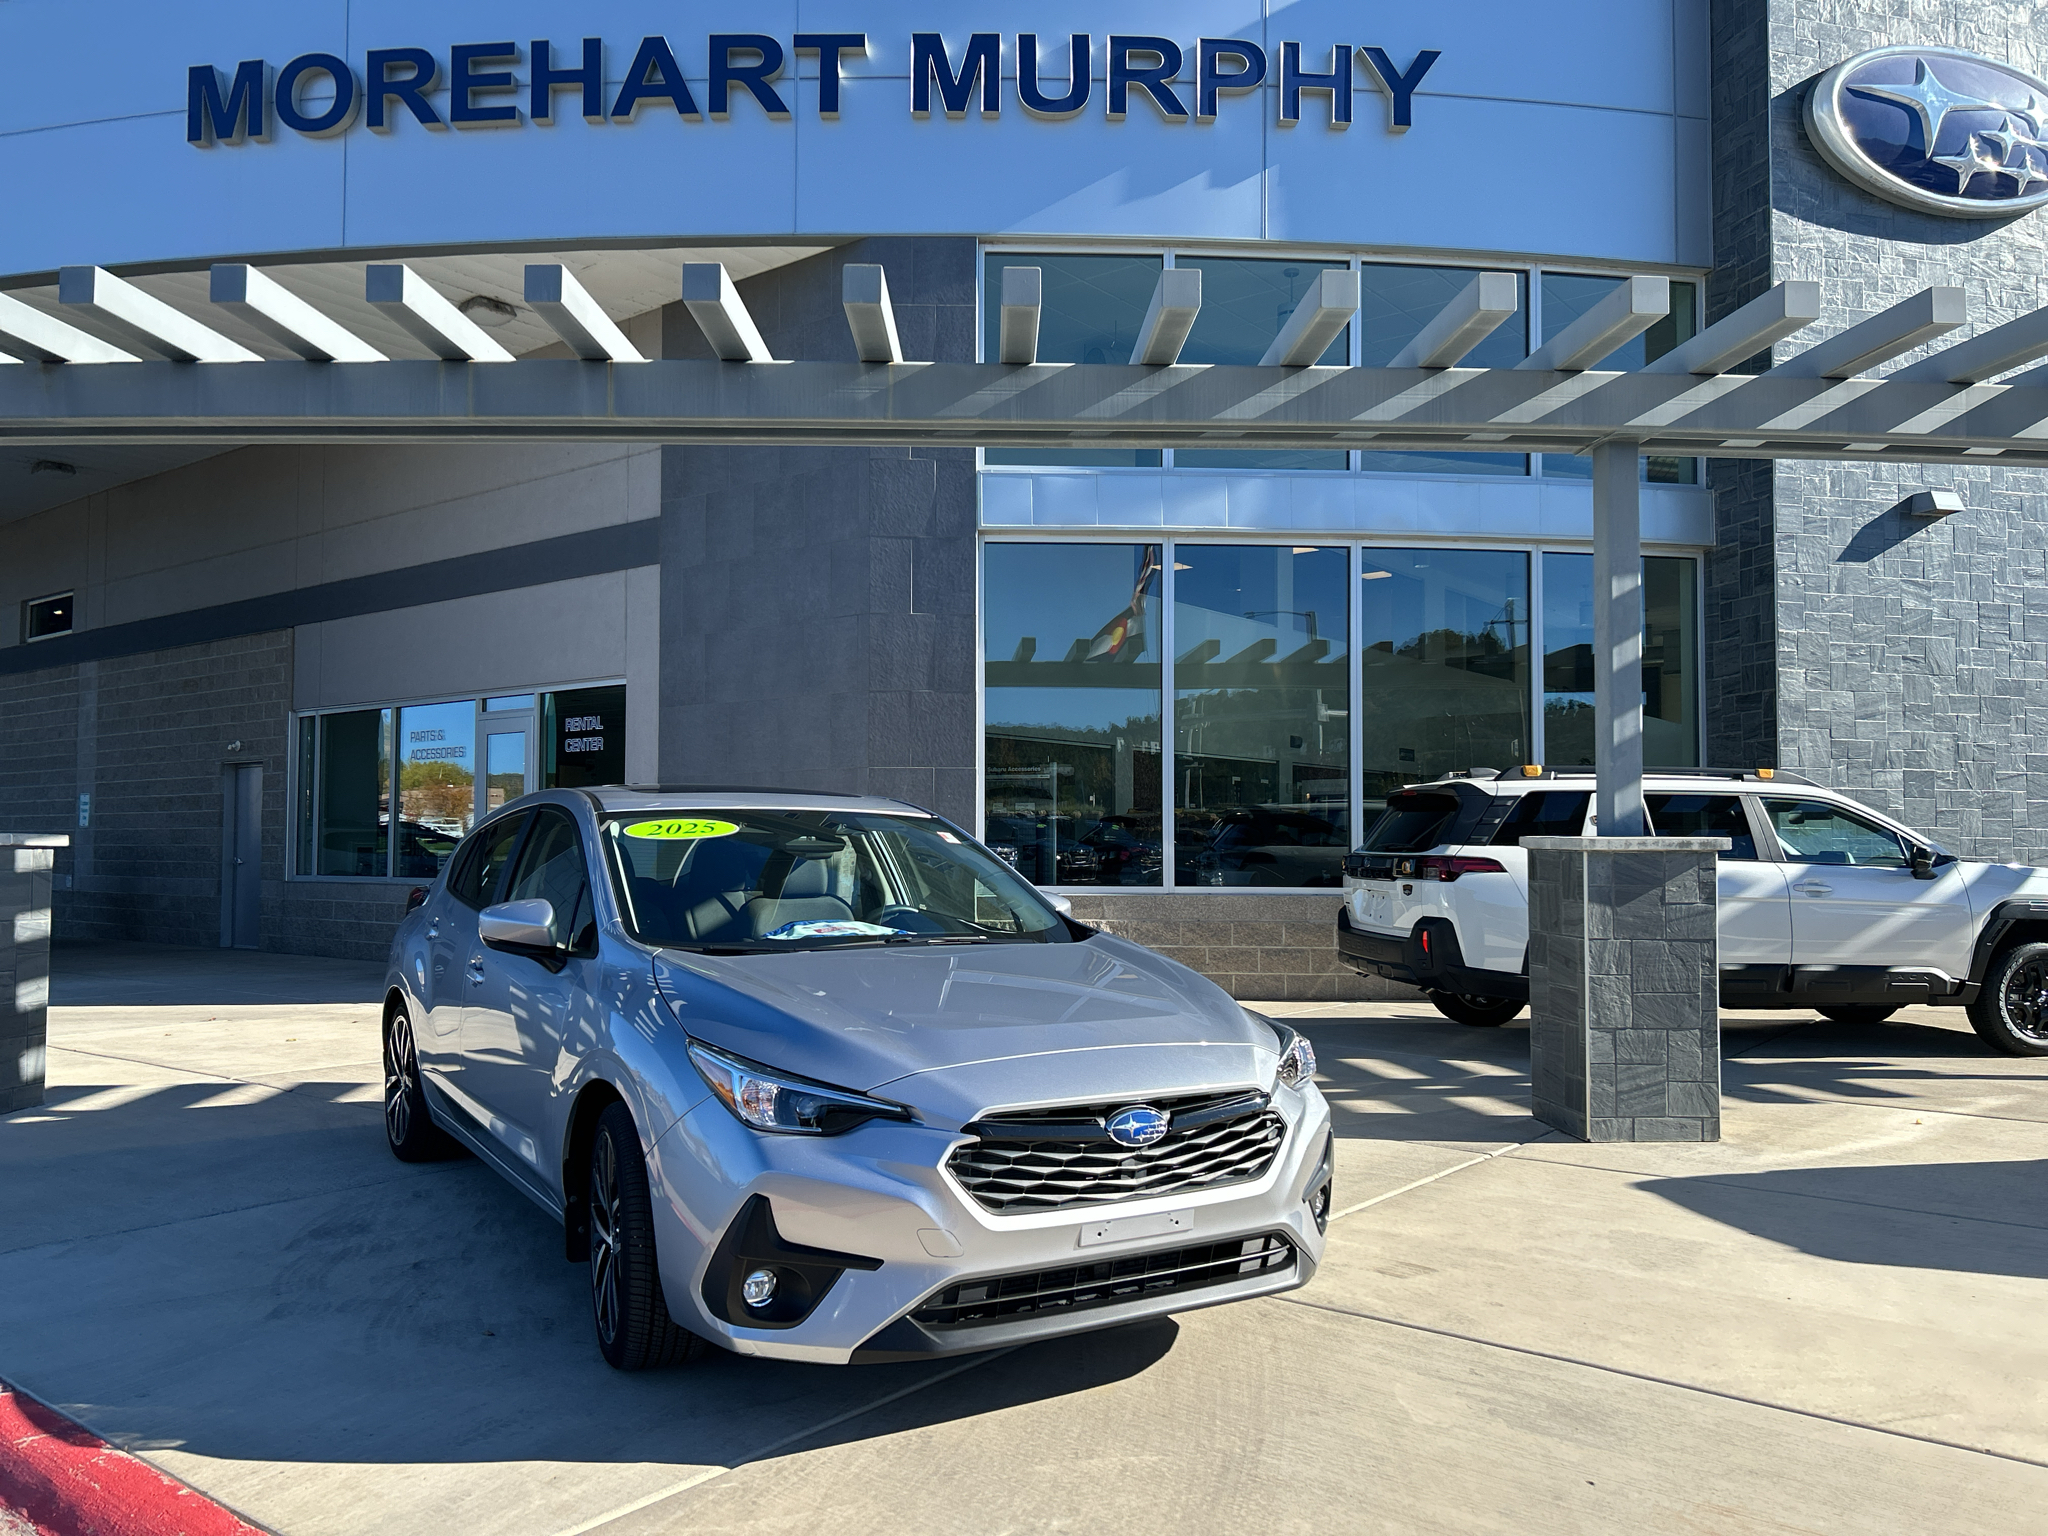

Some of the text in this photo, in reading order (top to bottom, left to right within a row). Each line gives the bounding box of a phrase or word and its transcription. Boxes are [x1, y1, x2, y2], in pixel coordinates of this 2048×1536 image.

[186, 33, 1442, 147] MOREHART MURPHY
[565, 715, 604, 732] RENTAL
[410, 729, 446, 743] PARTS &
[565, 737, 604, 752] CENTER
[410, 746, 466, 761] ACCESSORIES
[647, 822, 717, 836] 2025
